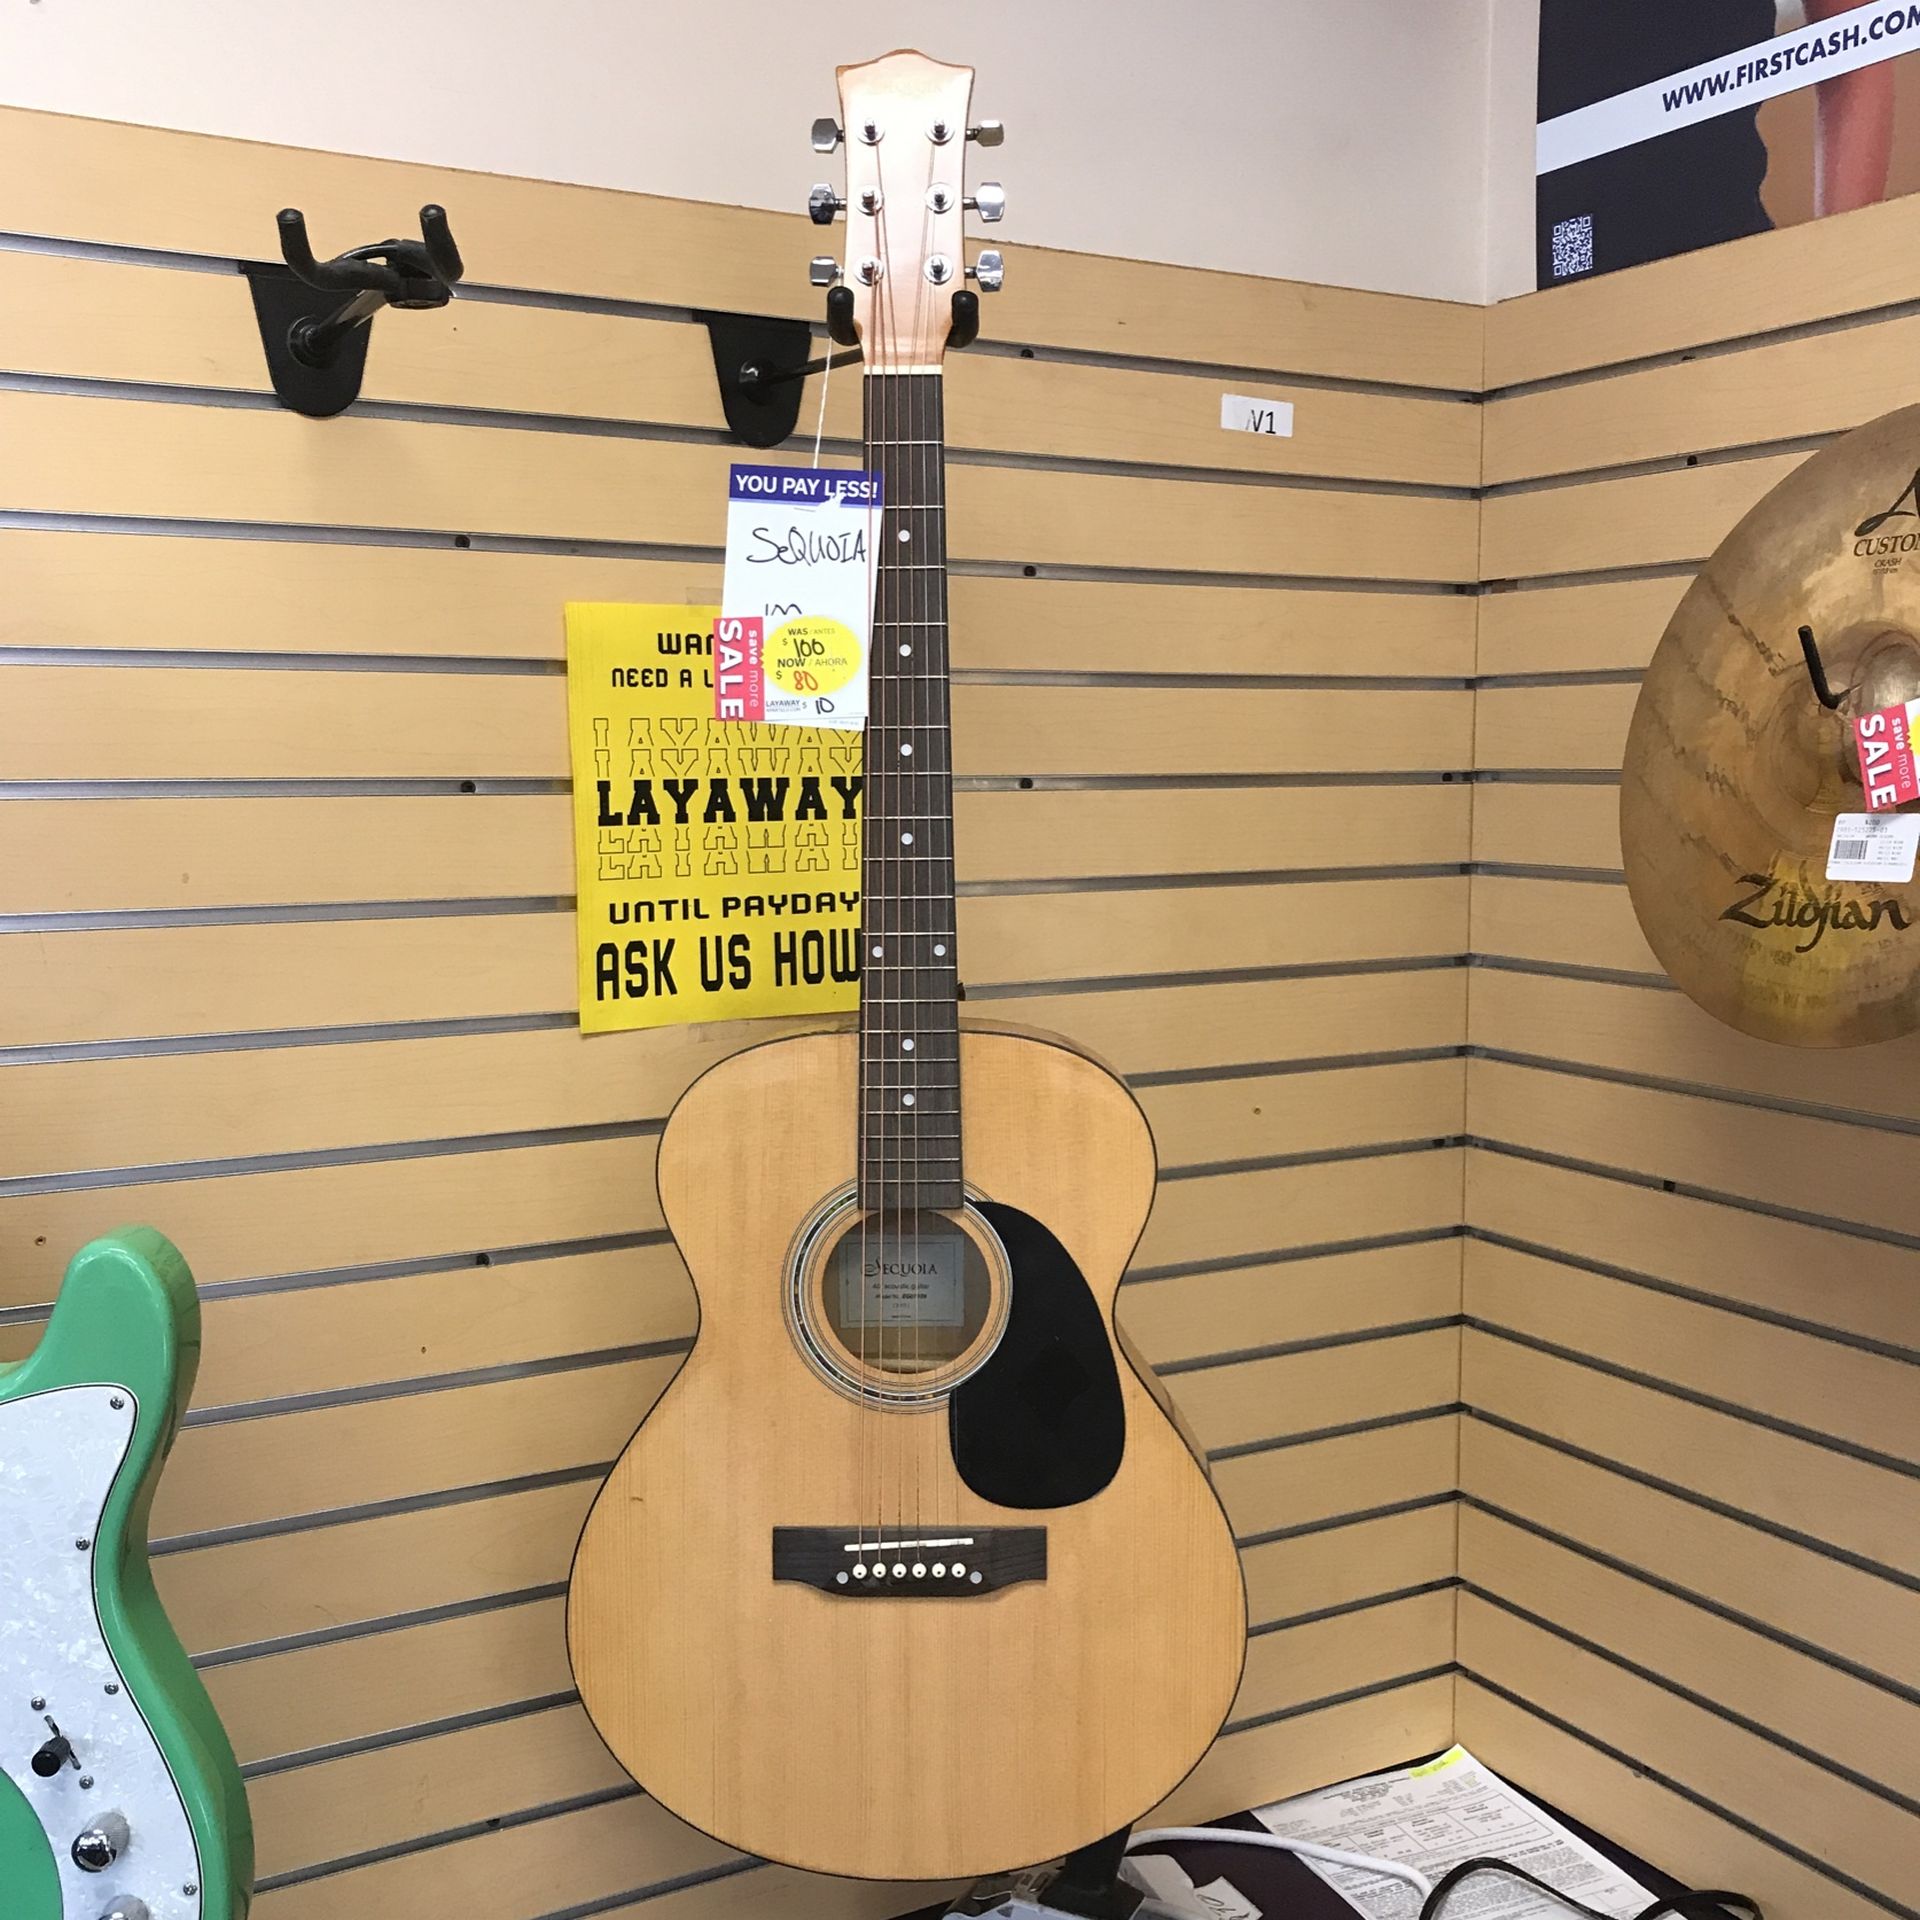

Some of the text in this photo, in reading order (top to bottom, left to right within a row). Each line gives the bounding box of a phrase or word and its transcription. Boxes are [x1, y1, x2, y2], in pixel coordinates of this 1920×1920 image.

[1662, 5, 1920, 112] WWW.FIRSTCASH.COM
[736, 475, 878, 498] YOU PAY LESS!
[1874, 557, 1902, 568] CRASH
[787, 627, 808, 636] WAS
[793, 638, 825, 658] 100
[612, 668, 668, 687] NEED
[680, 669, 692, 688] A
[719, 619, 744, 719] SALE
[748, 630, 759, 708] save more
[777, 657, 806, 668] NOW
[814, 657, 848, 667] AHORA
[793, 670, 819, 691] 80
[766, 699, 800, 708] LAYAWAY
[815, 697, 835, 715] 10
[1860, 714, 1897, 809] SALE
[1891, 718, 1912, 789] save more
[596, 776, 863, 827] LAYAWAY
[609, 891, 859, 924] UNTIL PAYDAY
[1718, 862, 1912, 953] Zildjian
[596, 928, 861, 1001] ASK US HOW
